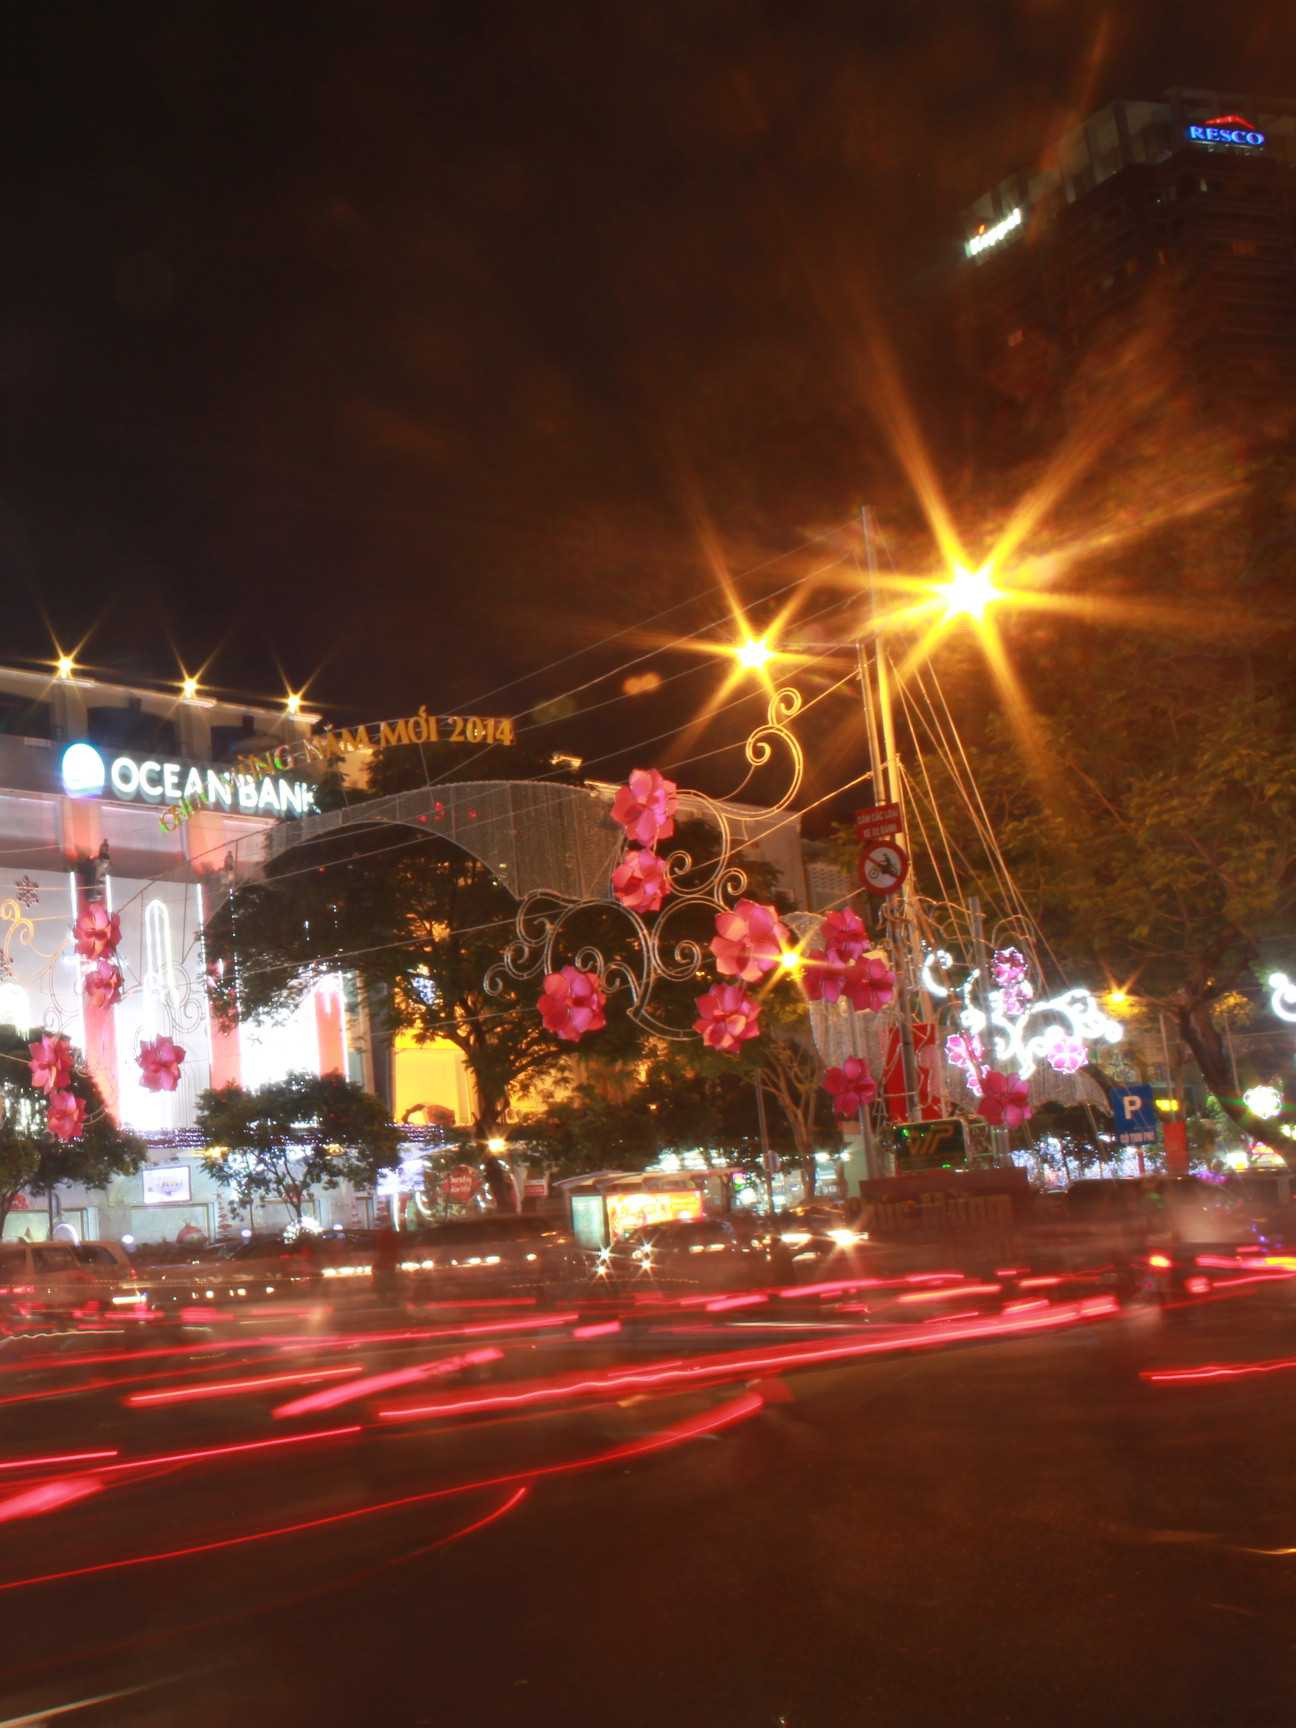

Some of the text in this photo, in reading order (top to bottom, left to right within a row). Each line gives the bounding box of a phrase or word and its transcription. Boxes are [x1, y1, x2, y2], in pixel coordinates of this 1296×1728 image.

[1190, 125, 1264, 146] RESCO
[380, 704, 439, 748] MỚI
[448, 716, 513, 746] 2014
[111, 756, 233, 806] OCEAN
[237, 773, 321, 816] BANK
[1123, 1095, 1142, 1119] P
